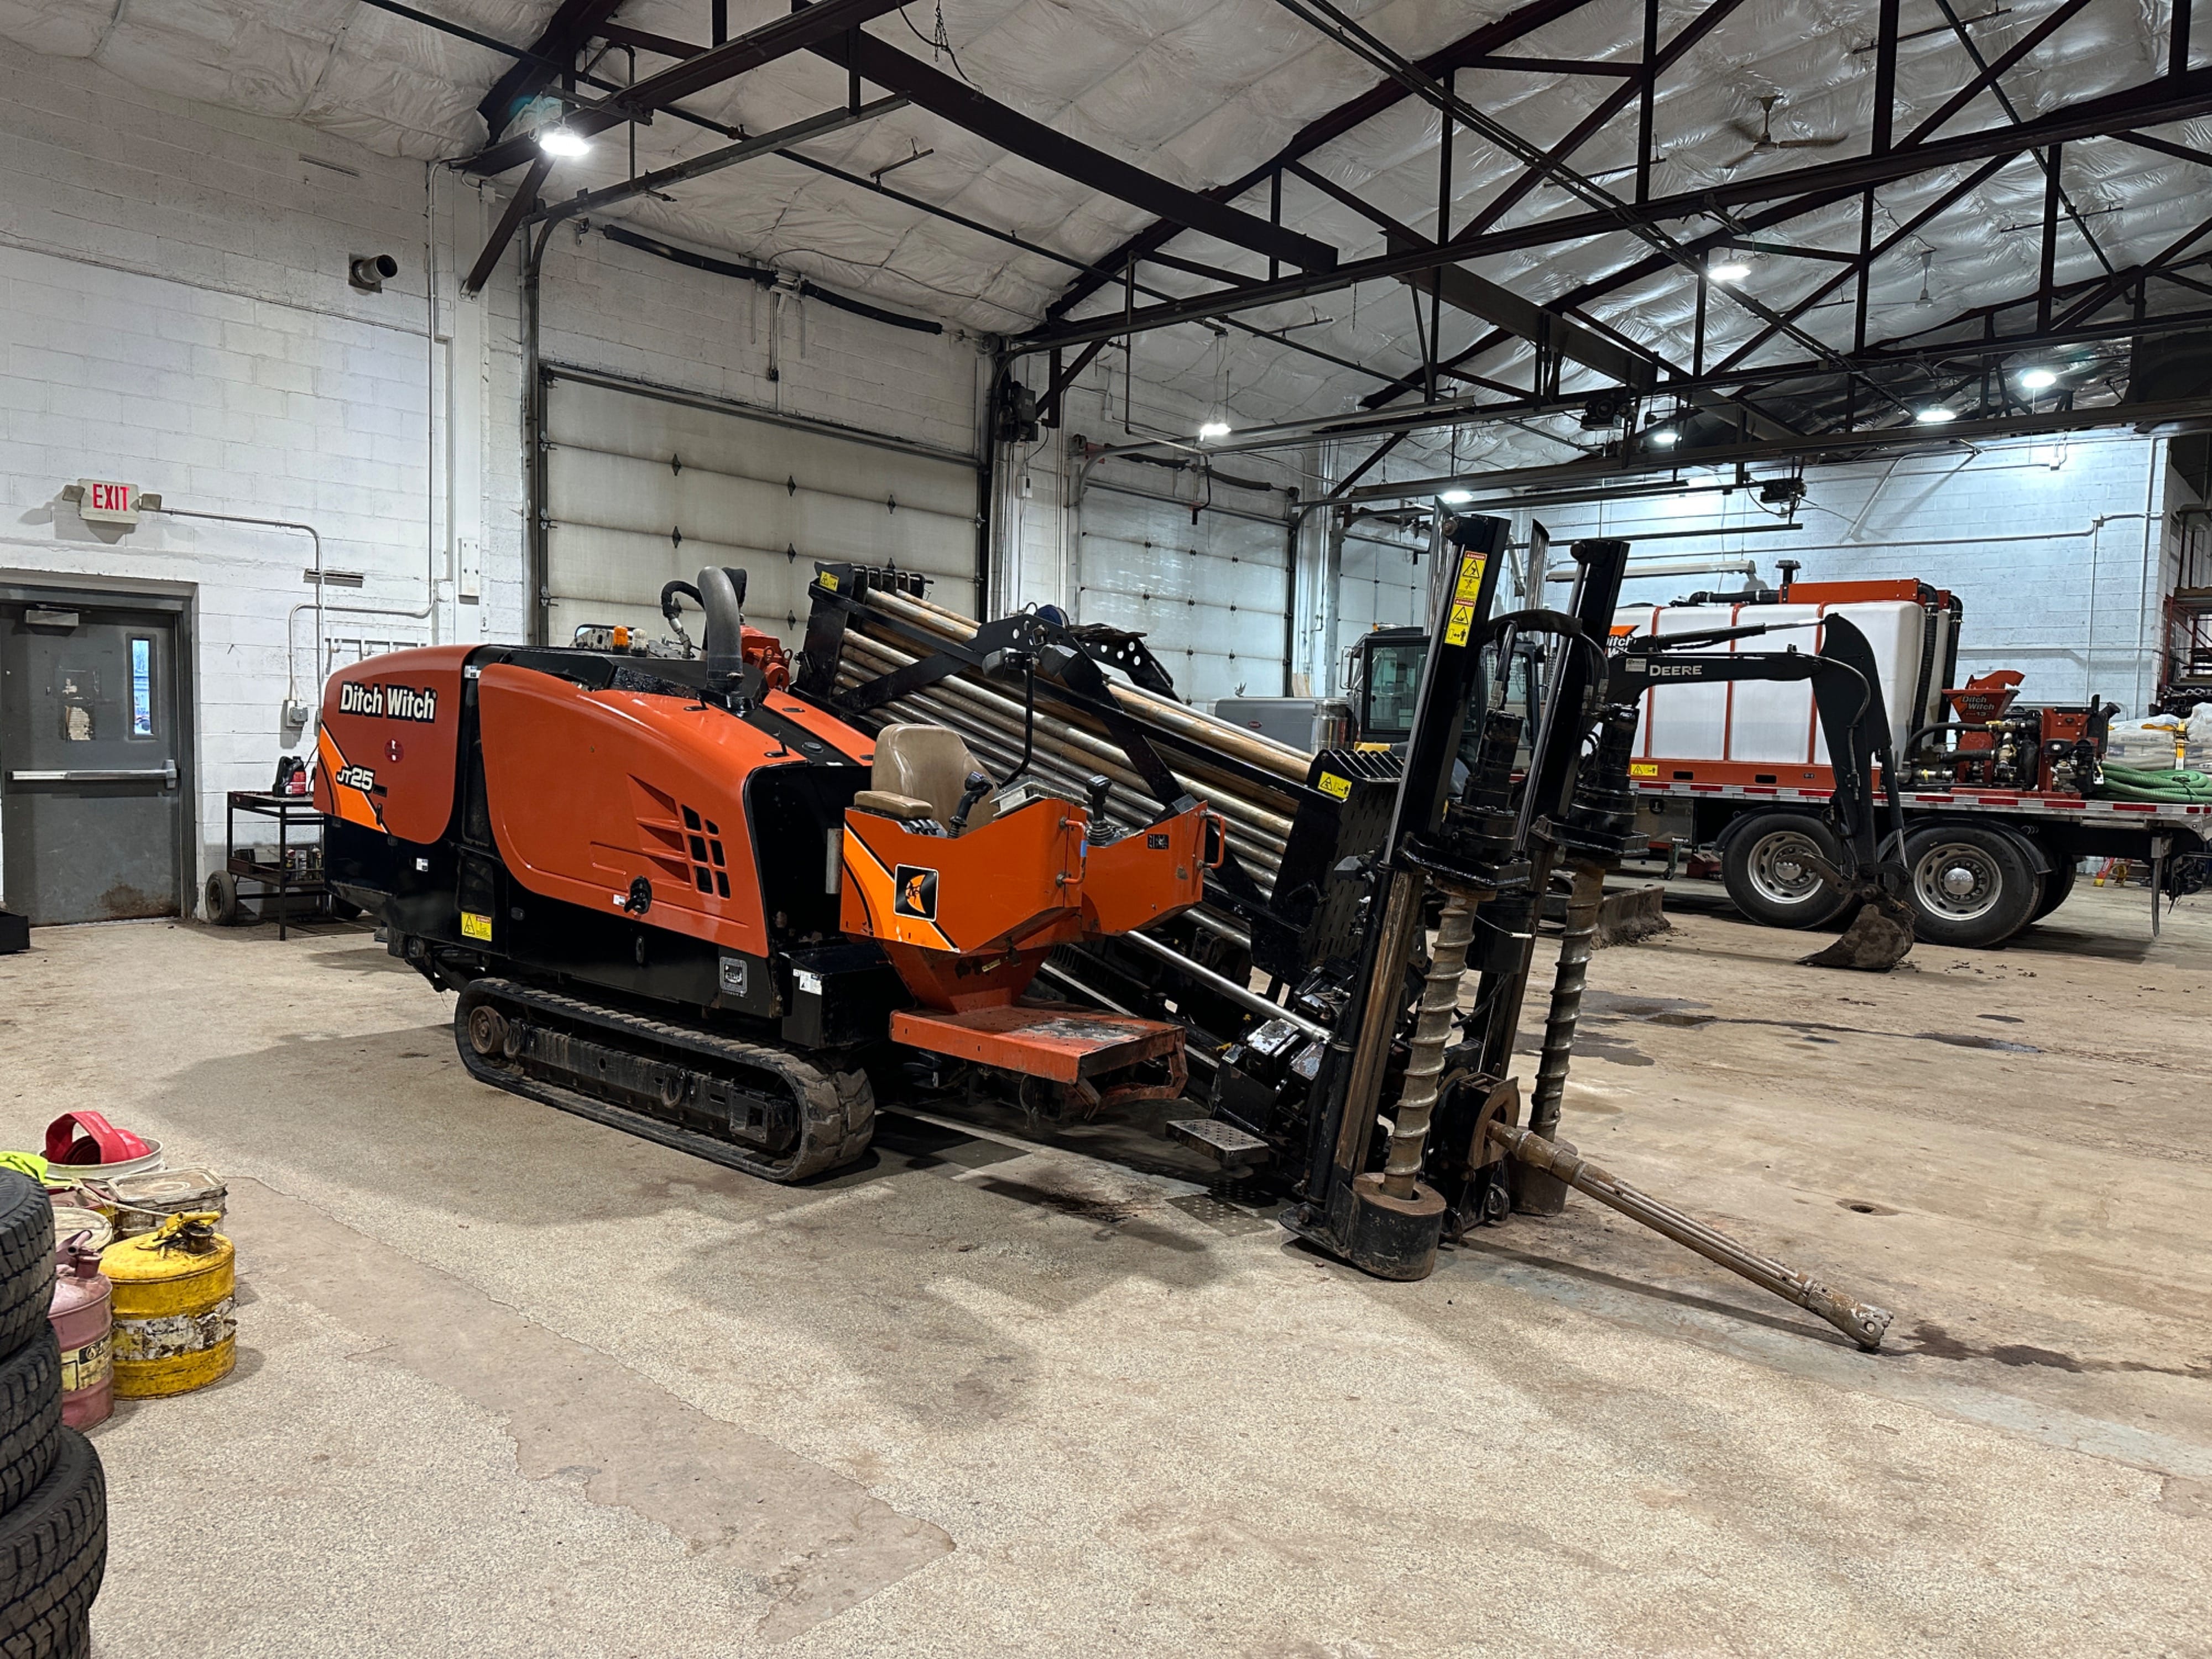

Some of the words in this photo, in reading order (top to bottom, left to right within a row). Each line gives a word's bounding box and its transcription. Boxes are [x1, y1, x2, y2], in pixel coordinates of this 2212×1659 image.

[93, 483, 129, 512] EXIT
[1649, 665, 1703, 676] DEERE
[340, 684, 383, 714] Ditch
[387, 687, 434, 719] Witch
[336, 767, 374, 791] JT25
